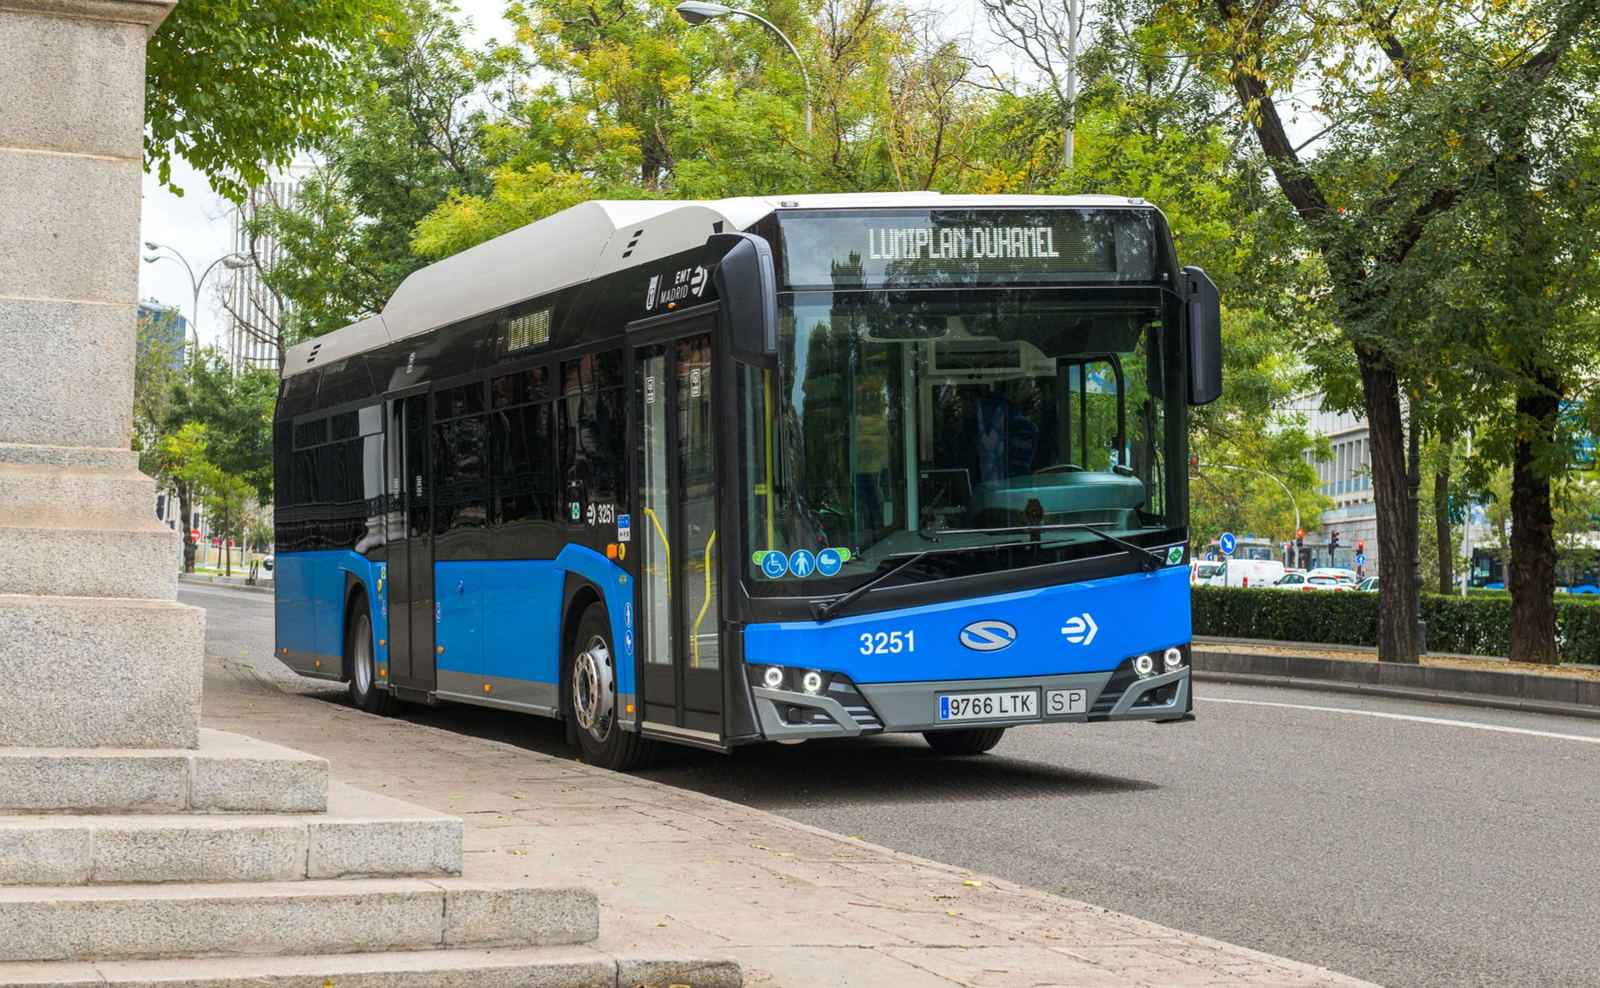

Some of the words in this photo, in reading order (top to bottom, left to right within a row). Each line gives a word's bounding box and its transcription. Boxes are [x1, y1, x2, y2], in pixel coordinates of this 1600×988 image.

[868, 226, 966, 260] LUMIPLAN
[972, 226, 1060, 259] DUHAMEL
[674, 267, 692, 285] EMT
[660, 284, 689, 304] MADRID
[597, 503, 615, 524] 3251
[859, 629, 915, 656] 3251
[950, 697, 993, 716] 9766
[999, 694, 1031, 713] LTK
[1051, 692, 1082, 711] SP
